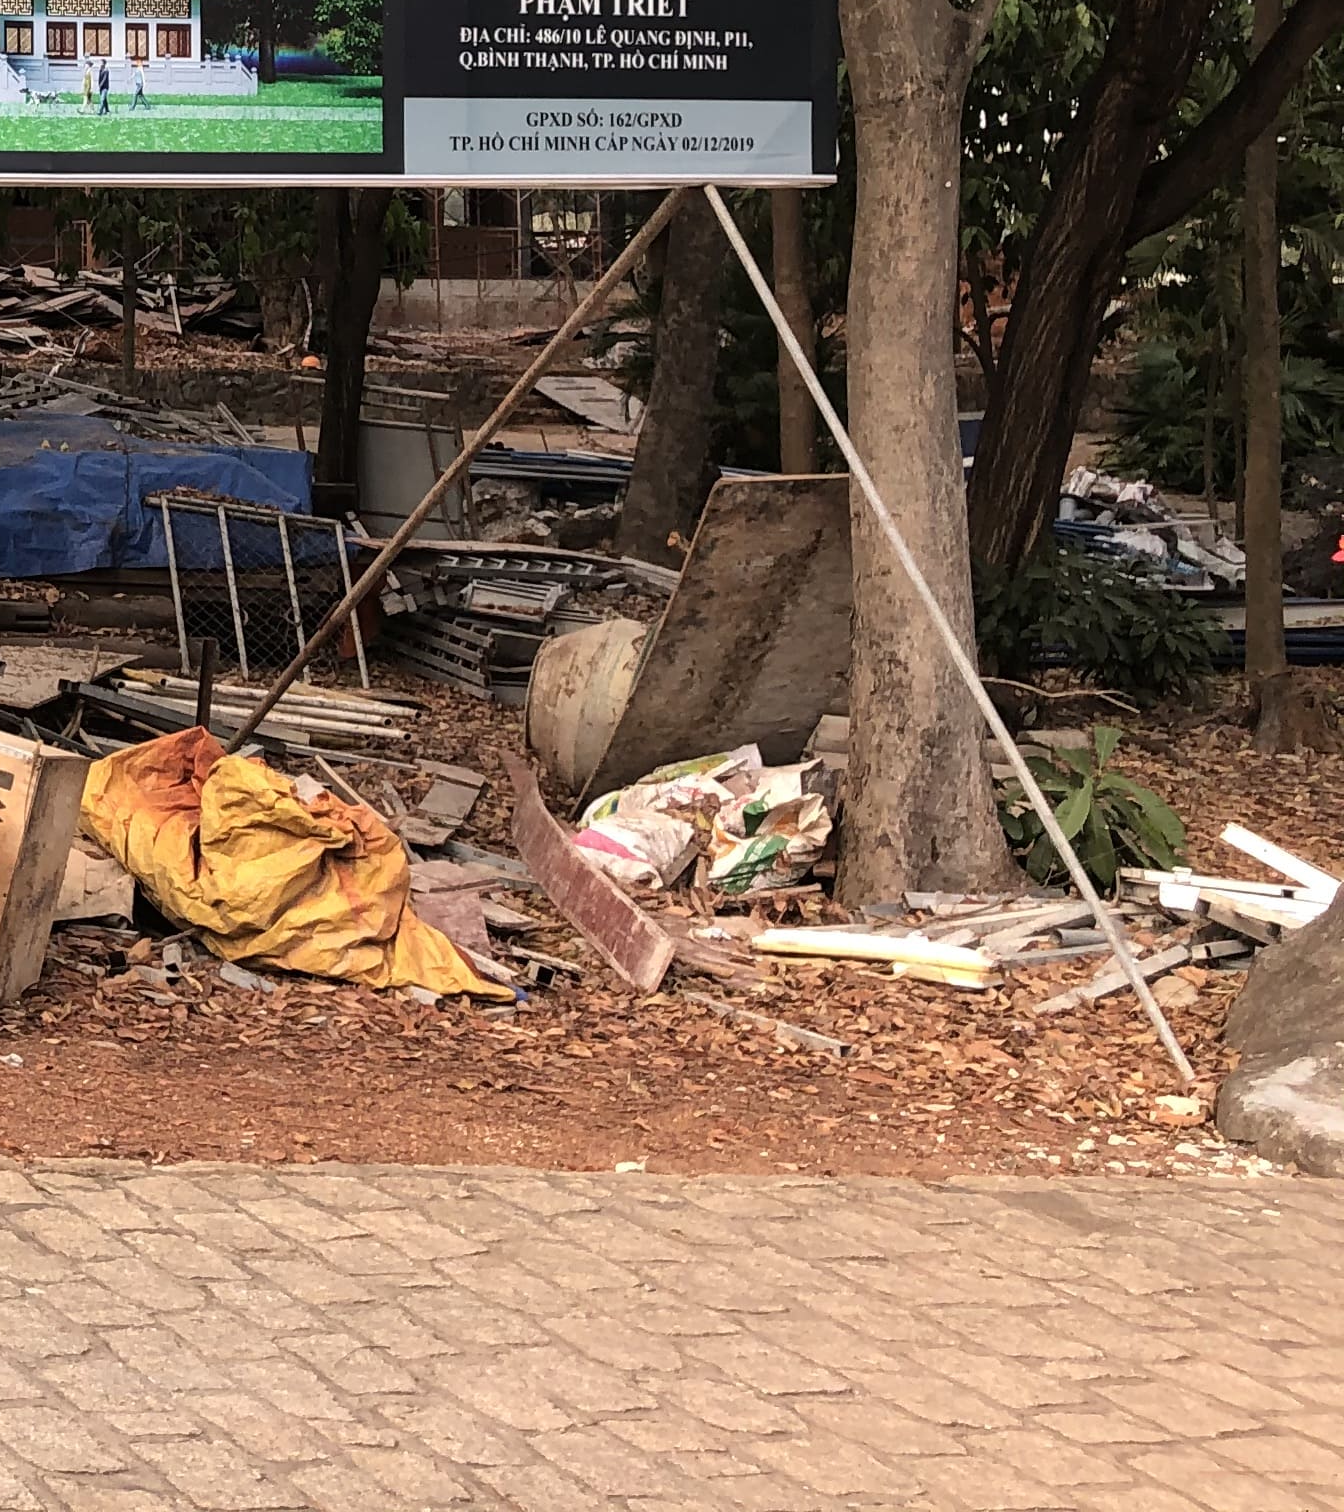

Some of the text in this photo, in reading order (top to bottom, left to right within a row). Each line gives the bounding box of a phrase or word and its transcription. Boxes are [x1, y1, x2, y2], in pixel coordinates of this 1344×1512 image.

[460, 27, 491, 47] ĐỊA
[535, 28, 582, 44] 486/10
[585, 24, 607, 45] LÊ
[610, 29, 671, 48] QUANG
[459, 47, 520, 70] Q.BÌNH
[523, 51, 589, 72] THẠNH,
[592, 52, 616, 69] TP.
[648, 49, 679, 70] CHÍ
[683, 54, 728, 70] MINH
[525, 111, 573, 128] GPXD
[609, 112, 683, 129] 162/GPXD
[449, 135, 474, 151] TP.
[508, 131, 540, 151] CHÍ
[544, 135, 590, 152] MINH
[631, 132, 678, 152] NGÀY
[681, 137, 755, 152] 02/12/2019
